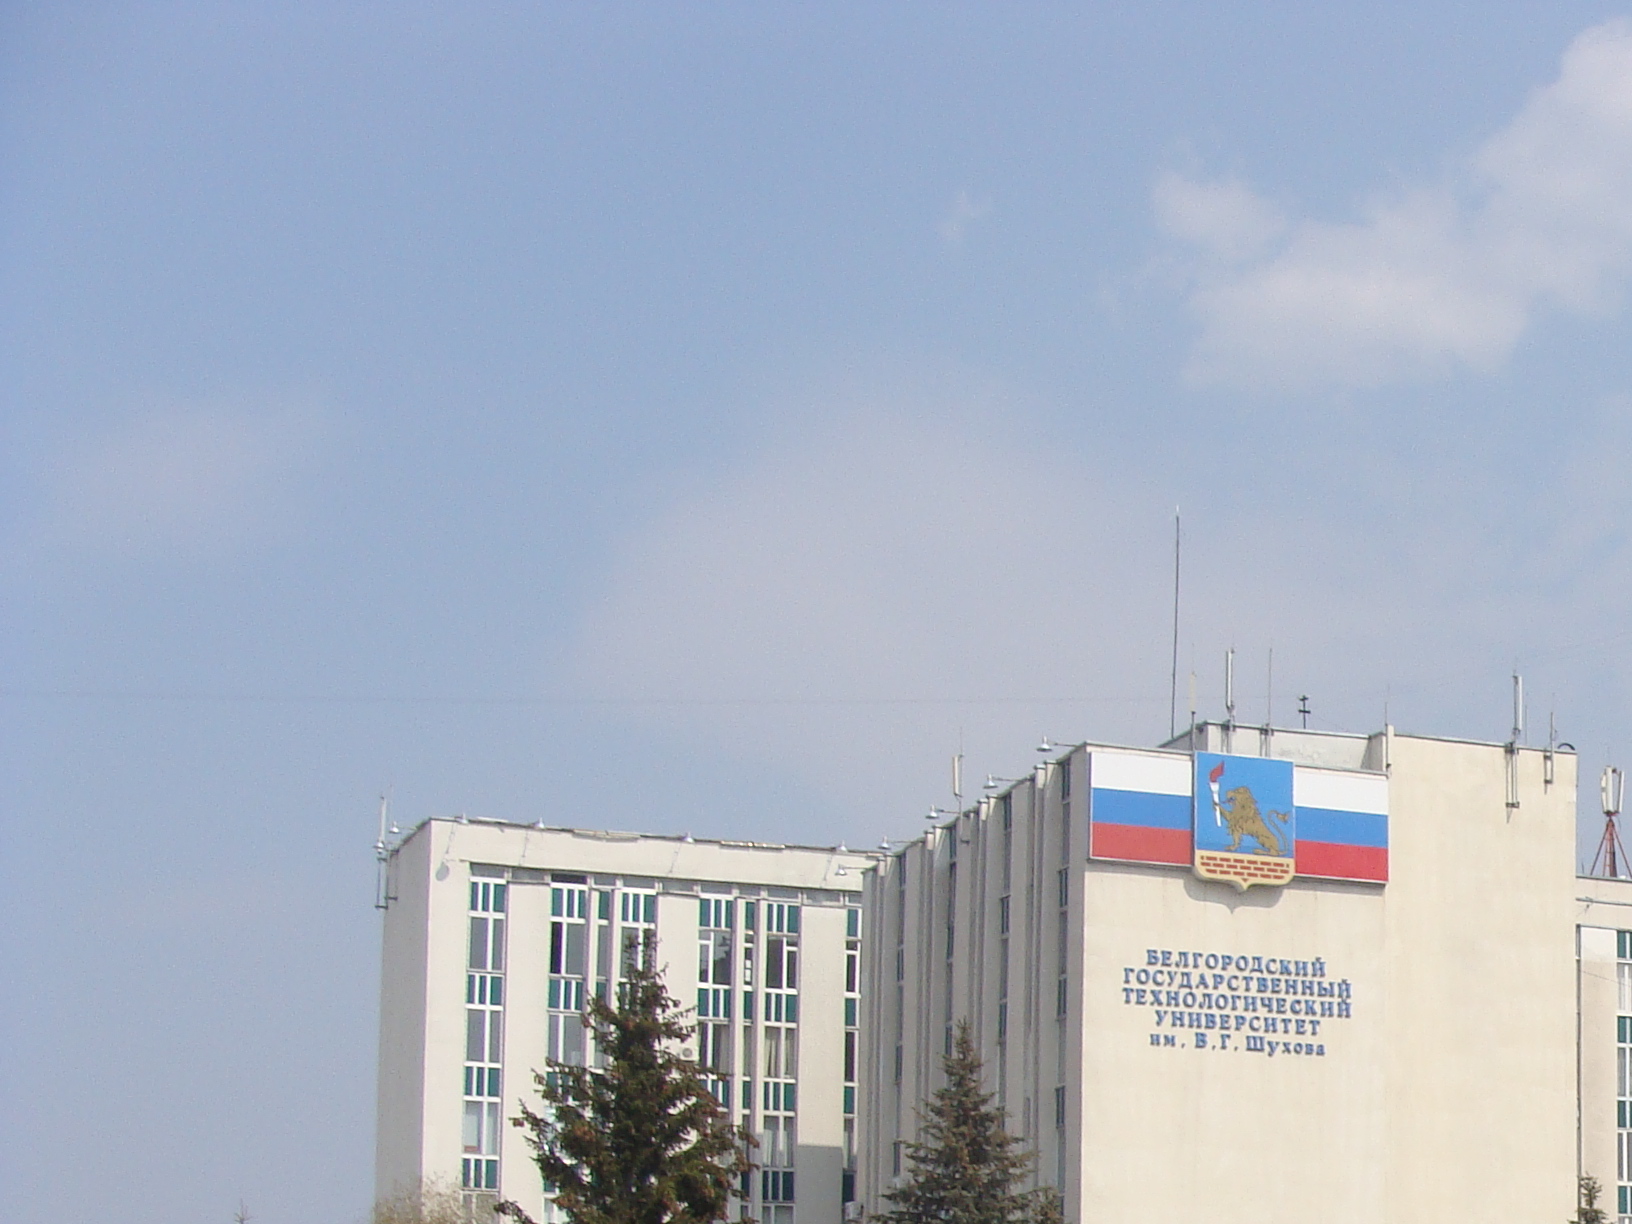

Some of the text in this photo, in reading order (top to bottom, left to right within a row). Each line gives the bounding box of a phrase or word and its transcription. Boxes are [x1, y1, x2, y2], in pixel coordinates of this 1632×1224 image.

[1146, 949, 1326, 977] БЕЛГОРОДСКИЙ
[1123, 967, 1352, 999] ГОСУДАРСТВЕННЫЙ
[1122, 986, 1352, 1018] ТЕХНОЛОГИЧЕСКИЙ
[1154, 1010, 1320, 1036] УНИВЕРСИТЕТ
[1246, 1035, 1326, 1057] Шухова
